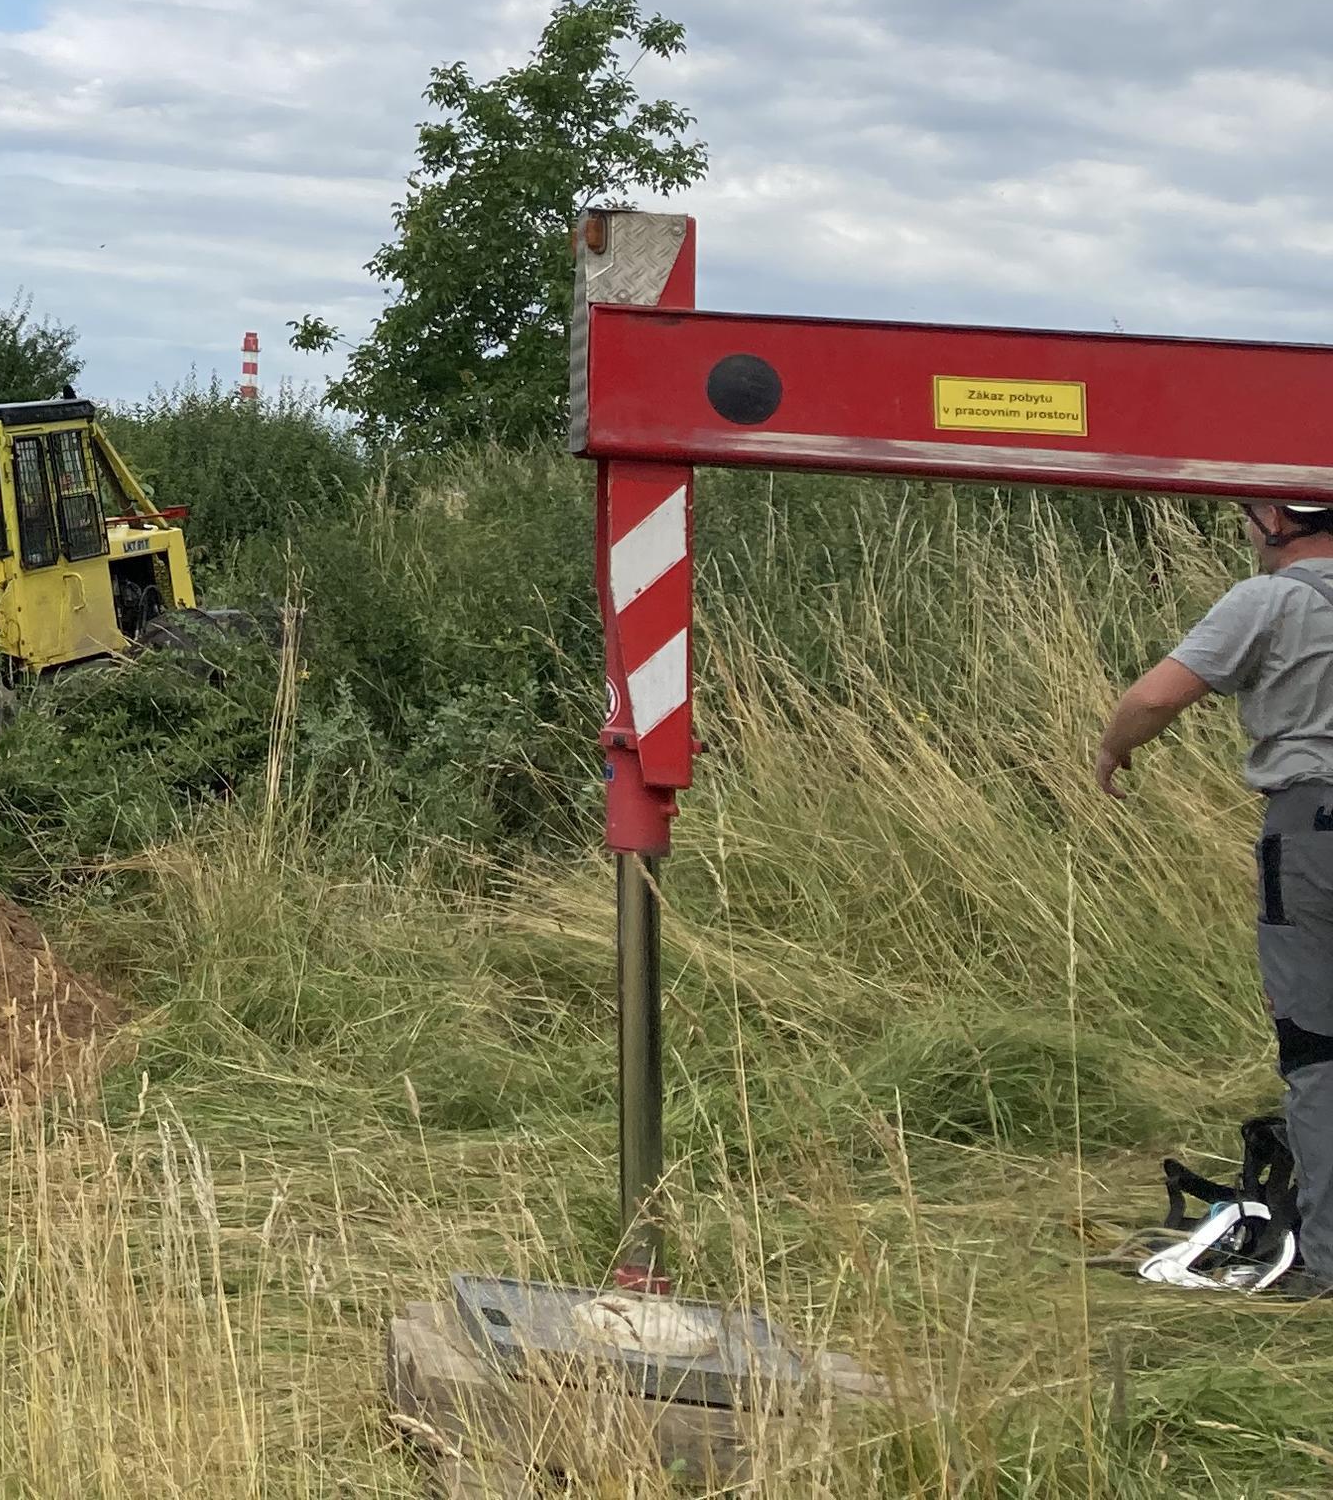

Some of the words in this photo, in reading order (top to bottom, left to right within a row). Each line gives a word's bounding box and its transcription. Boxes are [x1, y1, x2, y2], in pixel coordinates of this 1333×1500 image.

[967, 389, 1004, 401] Zákaz
[1009, 393, 1053, 405] pobytu
[943, 406, 950, 415] v
[1026, 410, 1079, 421] prostoru
